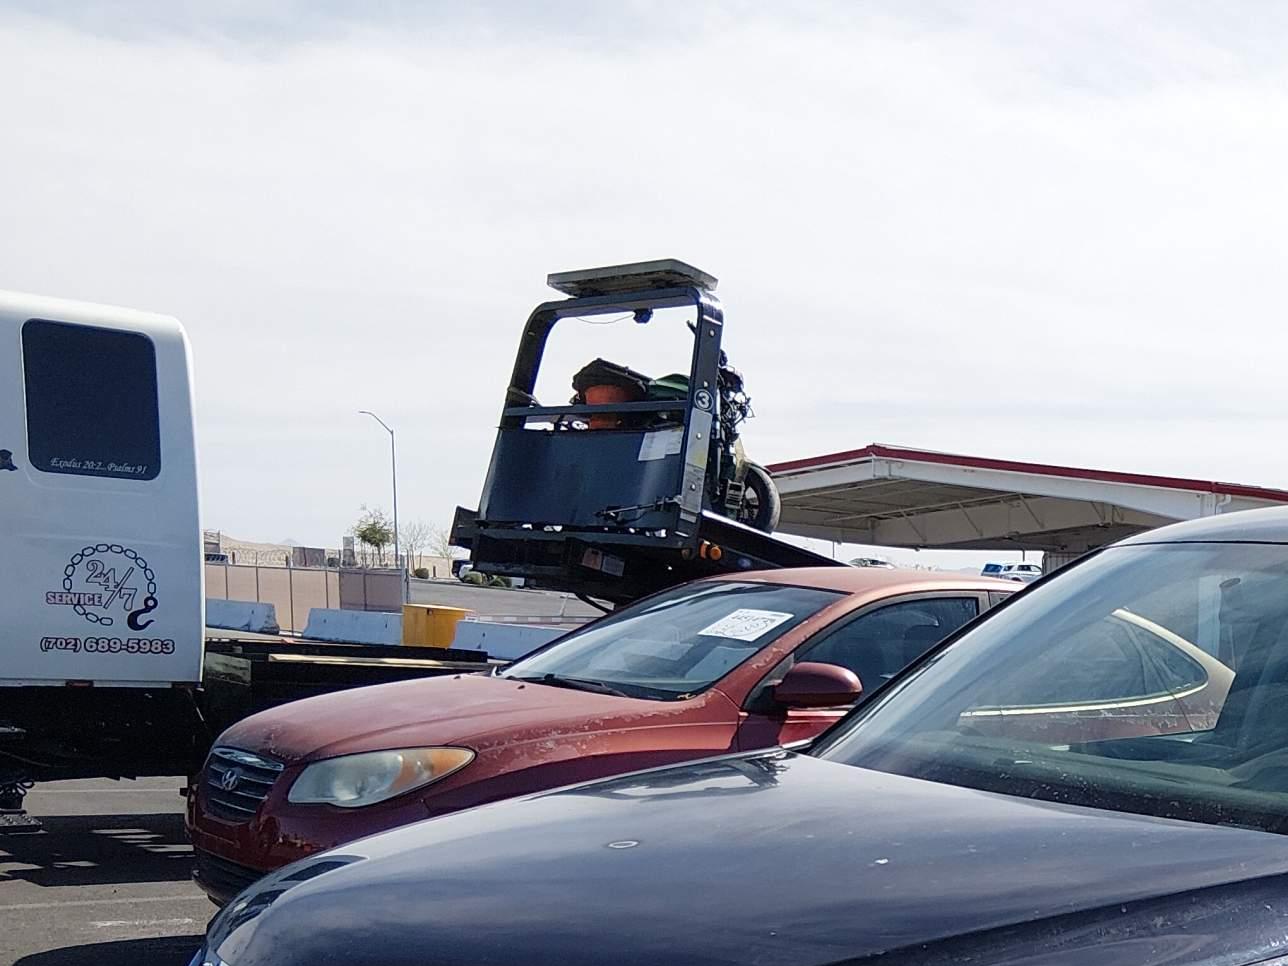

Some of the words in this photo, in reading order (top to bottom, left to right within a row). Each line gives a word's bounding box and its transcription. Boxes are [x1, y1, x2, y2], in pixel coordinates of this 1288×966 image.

[697, 392, 710, 409] 3
[46, 591, 103, 606] SERVICE
[40, 637, 81, 652] (702)
[84, 637, 175, 654] 689-5983
